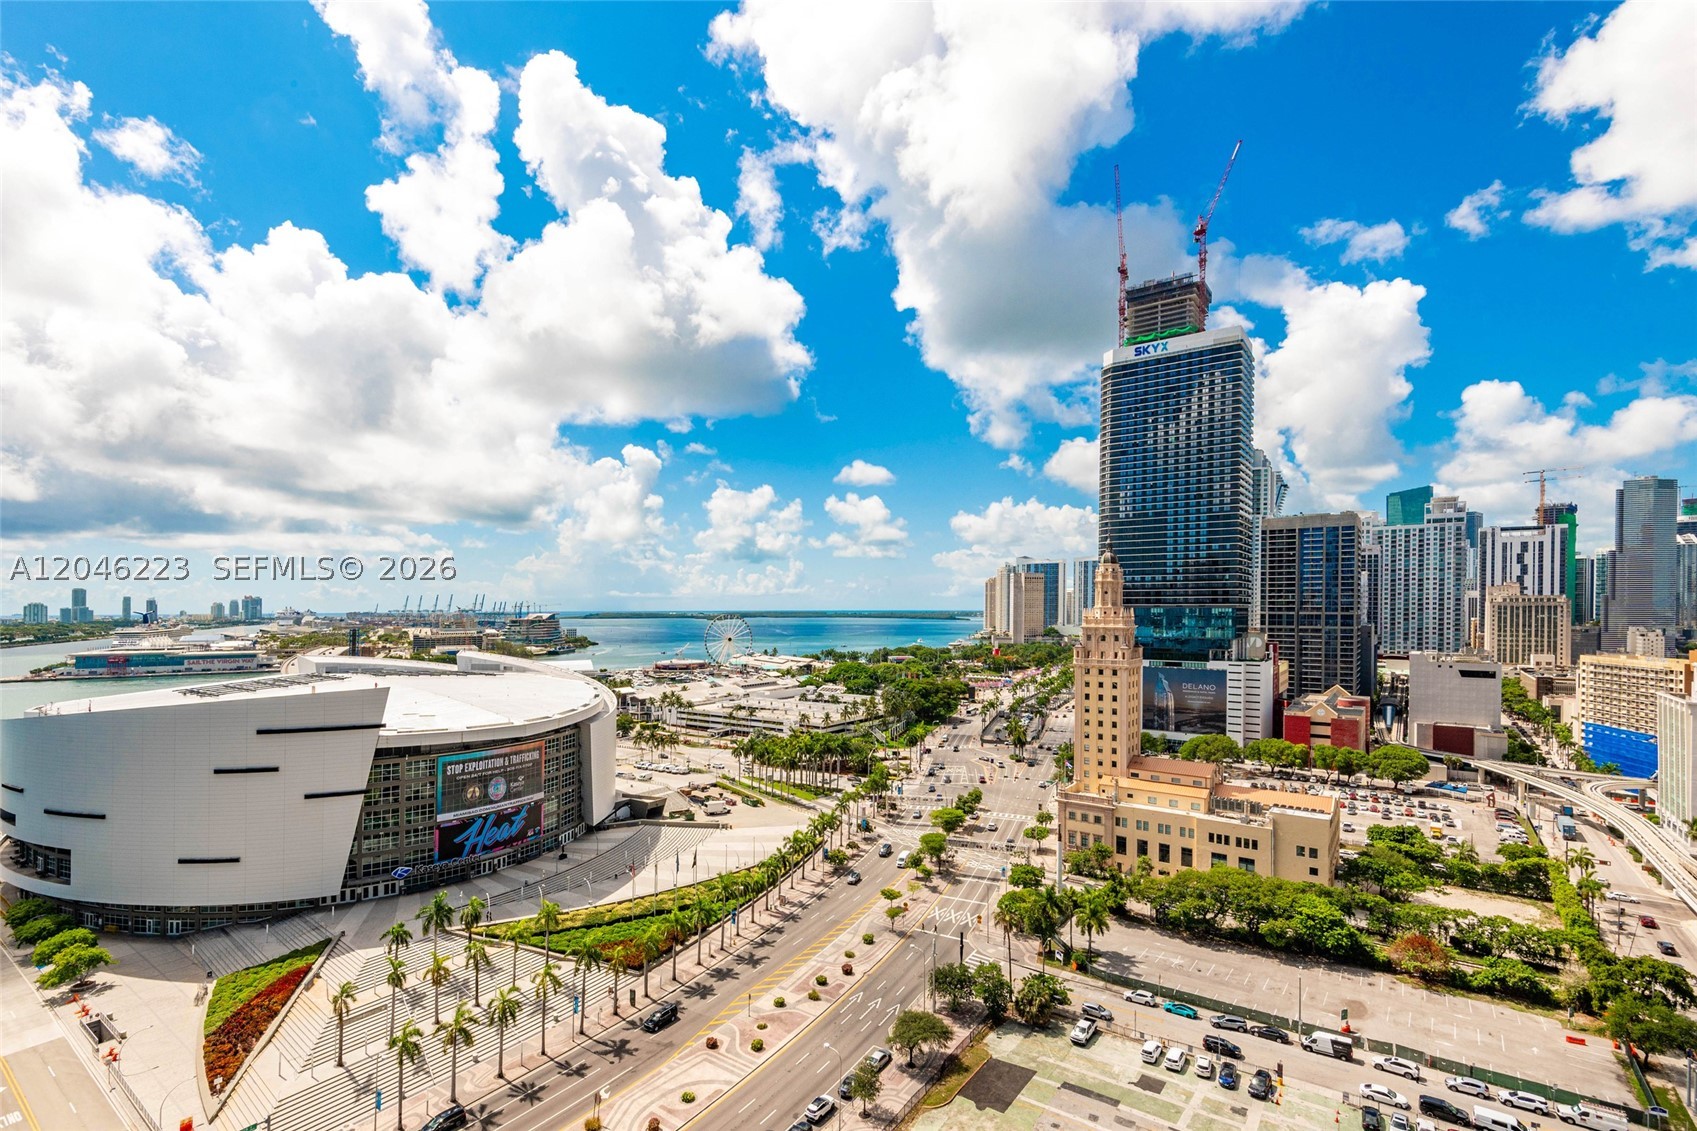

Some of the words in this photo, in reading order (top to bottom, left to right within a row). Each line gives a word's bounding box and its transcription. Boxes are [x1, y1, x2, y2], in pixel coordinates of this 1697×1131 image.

[1134, 341, 1168, 356] SKYX
[1182, 683, 1217, 691] DELANO
[447, 764, 463, 775] STOP
[464, 756, 503, 772] EXPLOITATION
[505, 757, 509, 766] &
[510, 750, 540, 764] TRAFFICKING
[454, 804, 530, 859] Heat
[414, 863, 449, 874] Kaseya
[451, 854, 481, 867] Center
[0, 1111, 22, 1128] ONL
